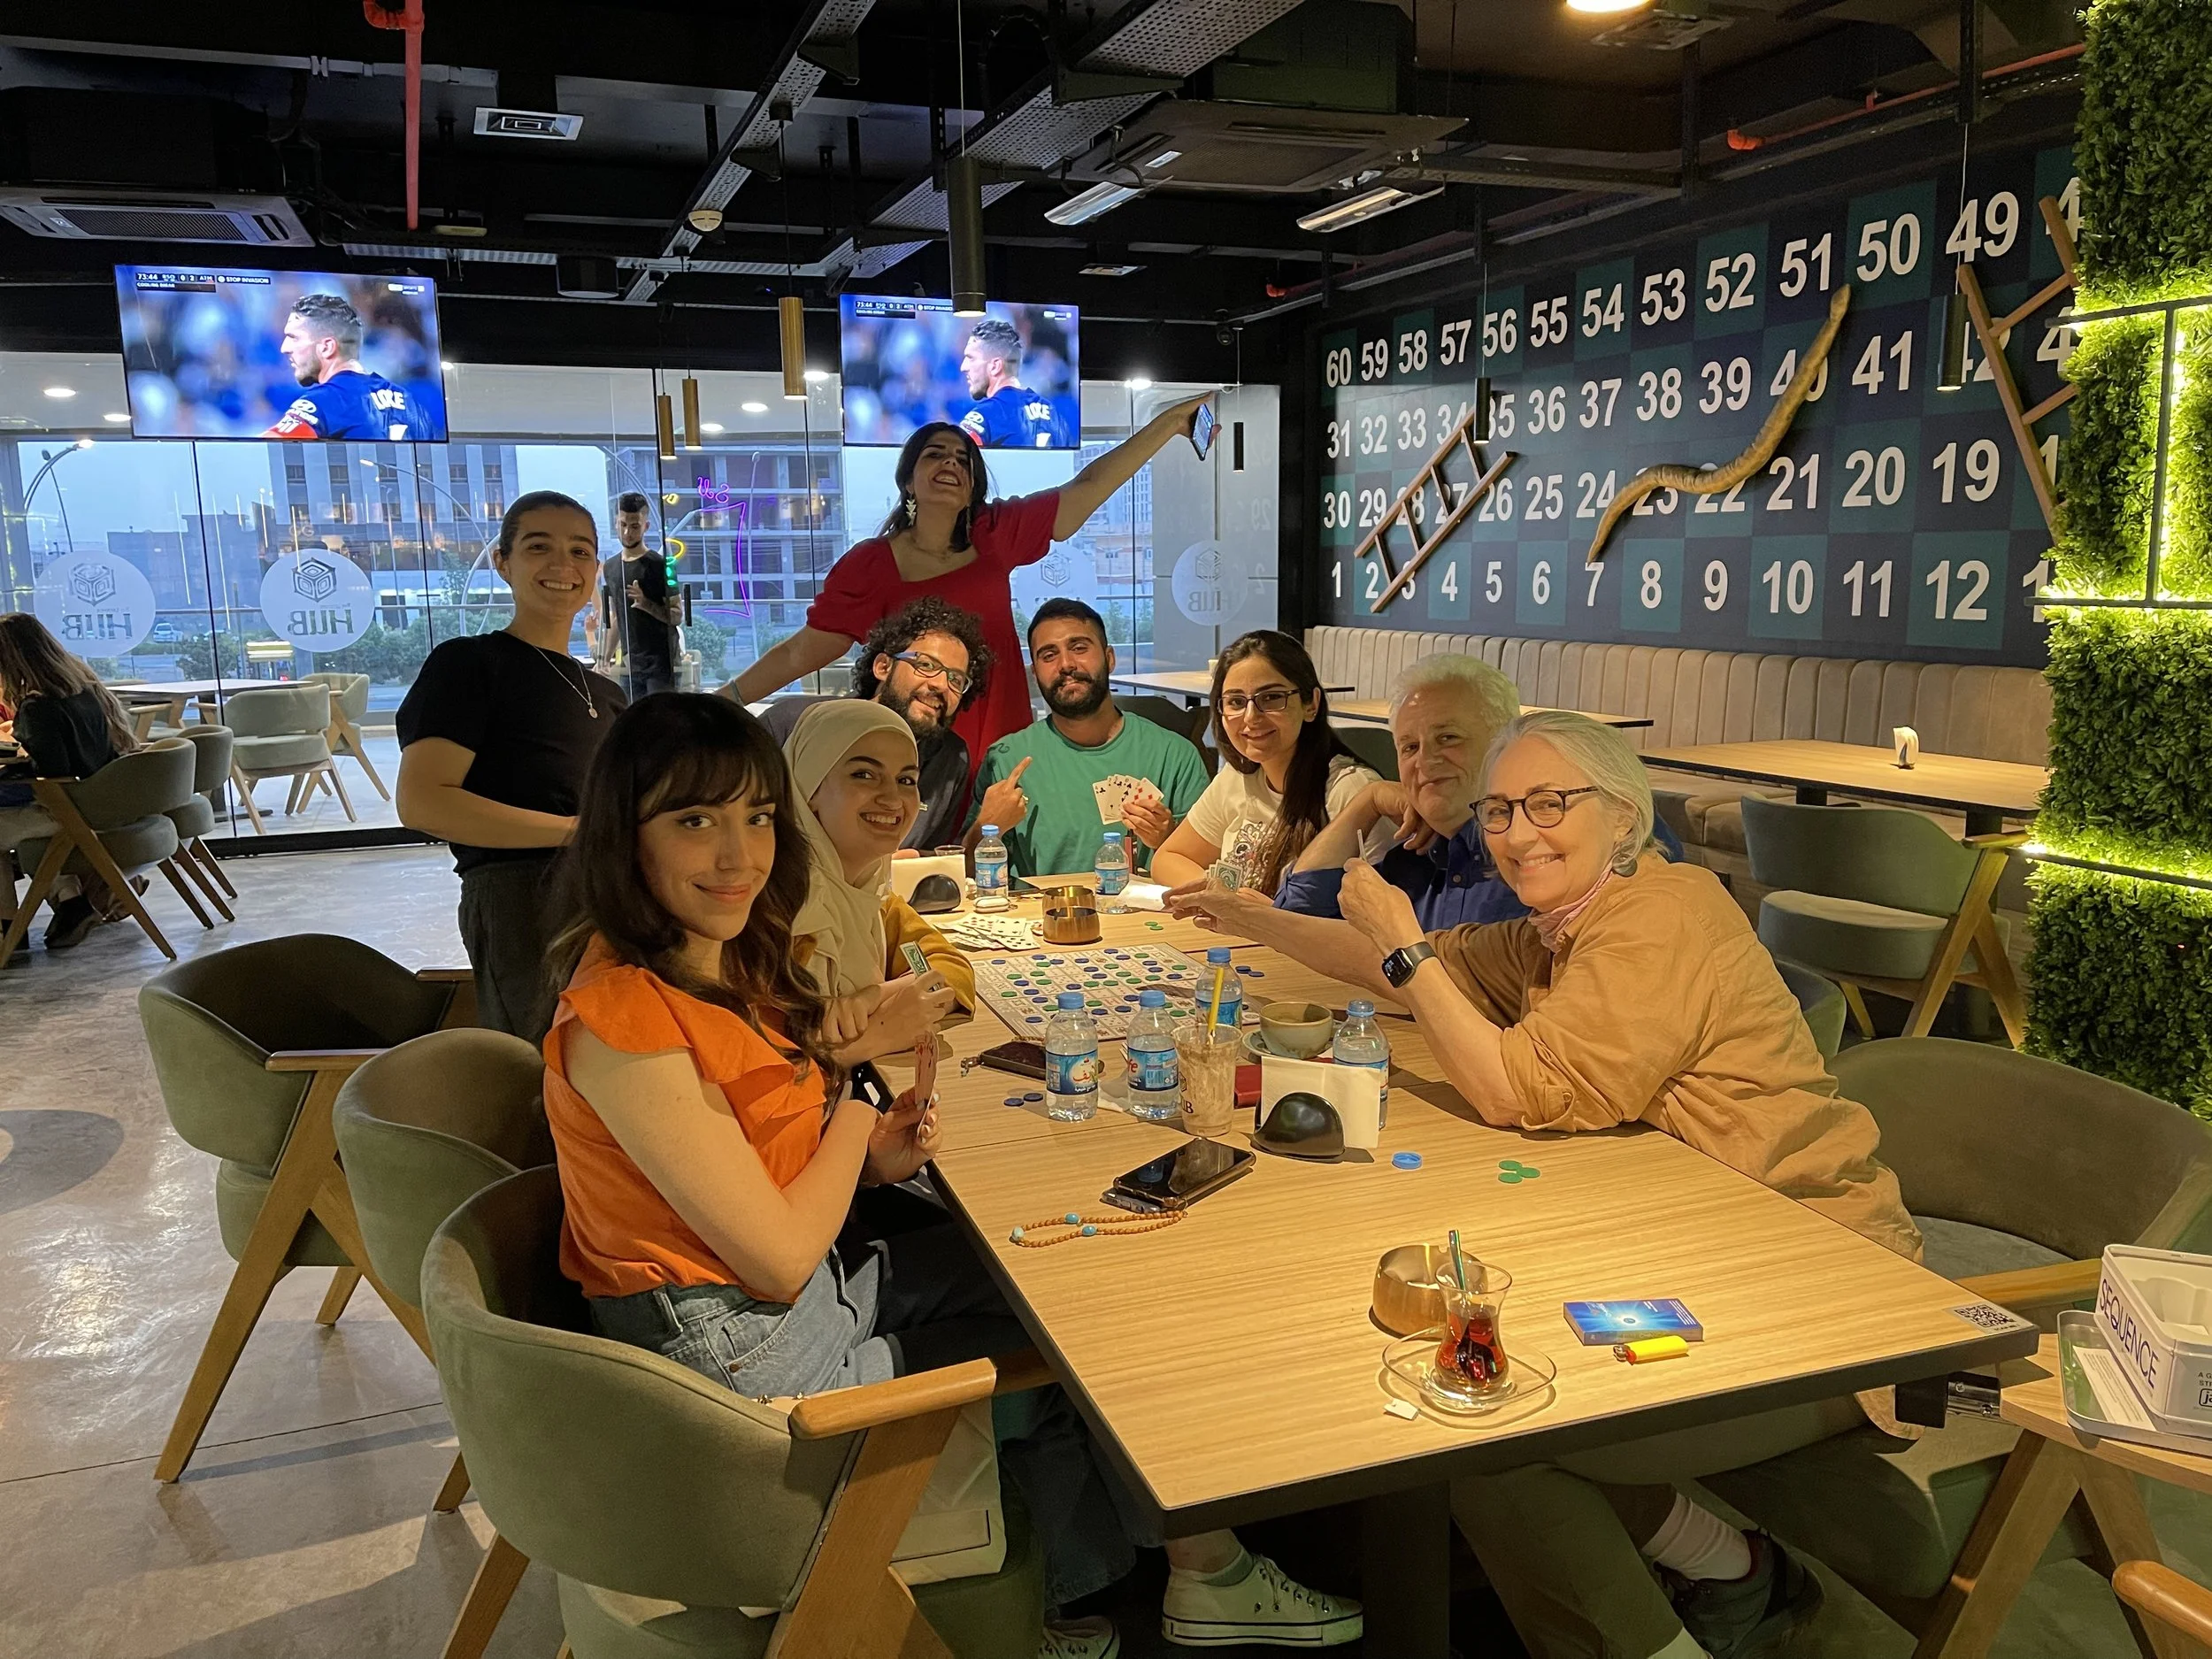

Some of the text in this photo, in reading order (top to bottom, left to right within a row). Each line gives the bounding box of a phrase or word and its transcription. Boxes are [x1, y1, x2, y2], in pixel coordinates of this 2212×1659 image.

[1327, 347, 1352, 388] 60
[1361, 338, 1388, 380] 59
[1398, 330, 1428, 373] 58
[1440, 320, 1472, 365] 57
[1482, 309, 1517, 357] 56
[1530, 296, 1568, 348] 55
[1582, 283, 1624, 337] 54
[1640, 269, 1686, 326] 53
[1706, 253, 1756, 313] 52
[1779, 233, 1832, 297] 51
[1856, 213, 1920, 282] 50
[1946, 191, 2019, 263] 49
[1327, 419, 1351, 458] 31
[1360, 414, 1387, 455] 32
[1398, 408, 1427, 449] 33
[1437, 402, 1468, 446] 34
[1528, 387, 1566, 434] 36
[1579, 379, 1622, 428] 37
[1637, 368, 1682, 419] 38
[1700, 357, 1752, 414] 39
[1770, 349, 1828, 402] 40
[1852, 331, 1912, 395] 41
[1324, 492, 1351, 529] 30
[1359, 488, 1386, 527] 29
[1396, 486, 1425, 526] 28
[1479, 478, 1513, 521] 26
[1525, 474, 1563, 520] 25
[1576, 470, 1616, 518] 24
[1766, 454, 1820, 511] 21
[1842, 447, 1905, 507] 20
[1932, 440, 2000, 503] 19
[1332, 561, 1341, 598] 1
[1365, 561, 1379, 599] 2
[1401, 561, 1416, 600] 3
[1441, 561, 1458, 602] 4
[1486, 561, 1502, 603] 5
[1532, 561, 1551, 604] 6
[1584, 561, 1605, 607] 7
[1640, 561, 1662, 610] 8
[1704, 561, 1728, 611] 9
[1763, 560, 1815, 614] 10
[1843, 560, 1893, 617] 11
[1925, 560, 1991, 620] 12
[2100, 1279, 2160, 1389] SEQUENCE
